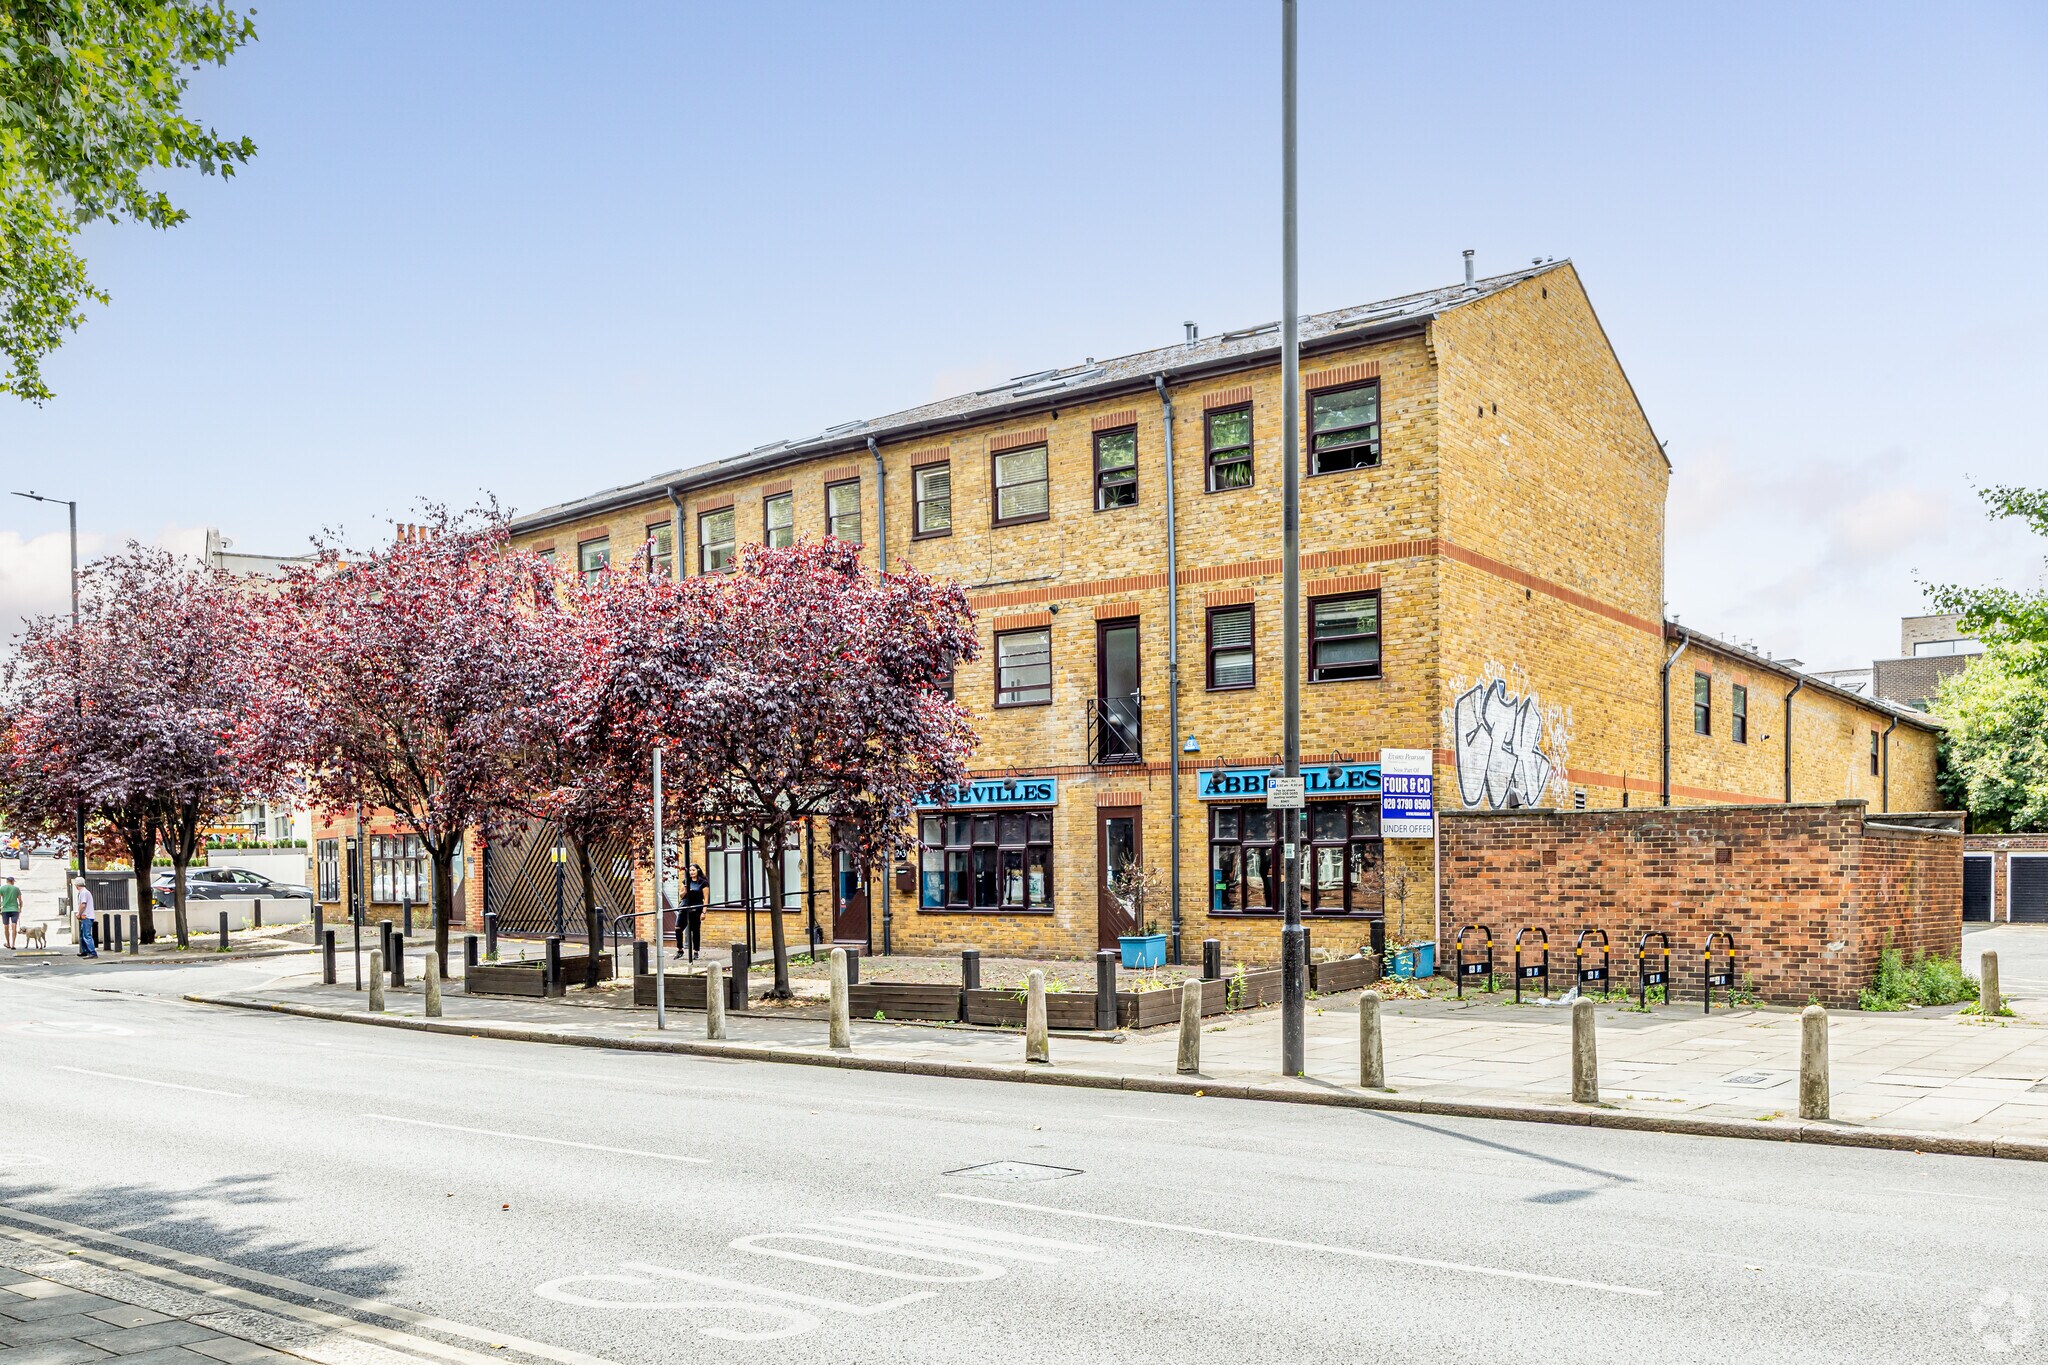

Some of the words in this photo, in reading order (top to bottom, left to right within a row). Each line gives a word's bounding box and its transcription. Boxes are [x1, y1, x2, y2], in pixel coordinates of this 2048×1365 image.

[1384, 777, 1408, 793] FOUR
[1409, 777, 1417, 793] &
[1383, 798, 1396, 809] 020
[1396, 798, 1413, 810] 3790
[1414, 798, 1431, 810] 8500
[1409, 825, 1432, 833] OFFER
